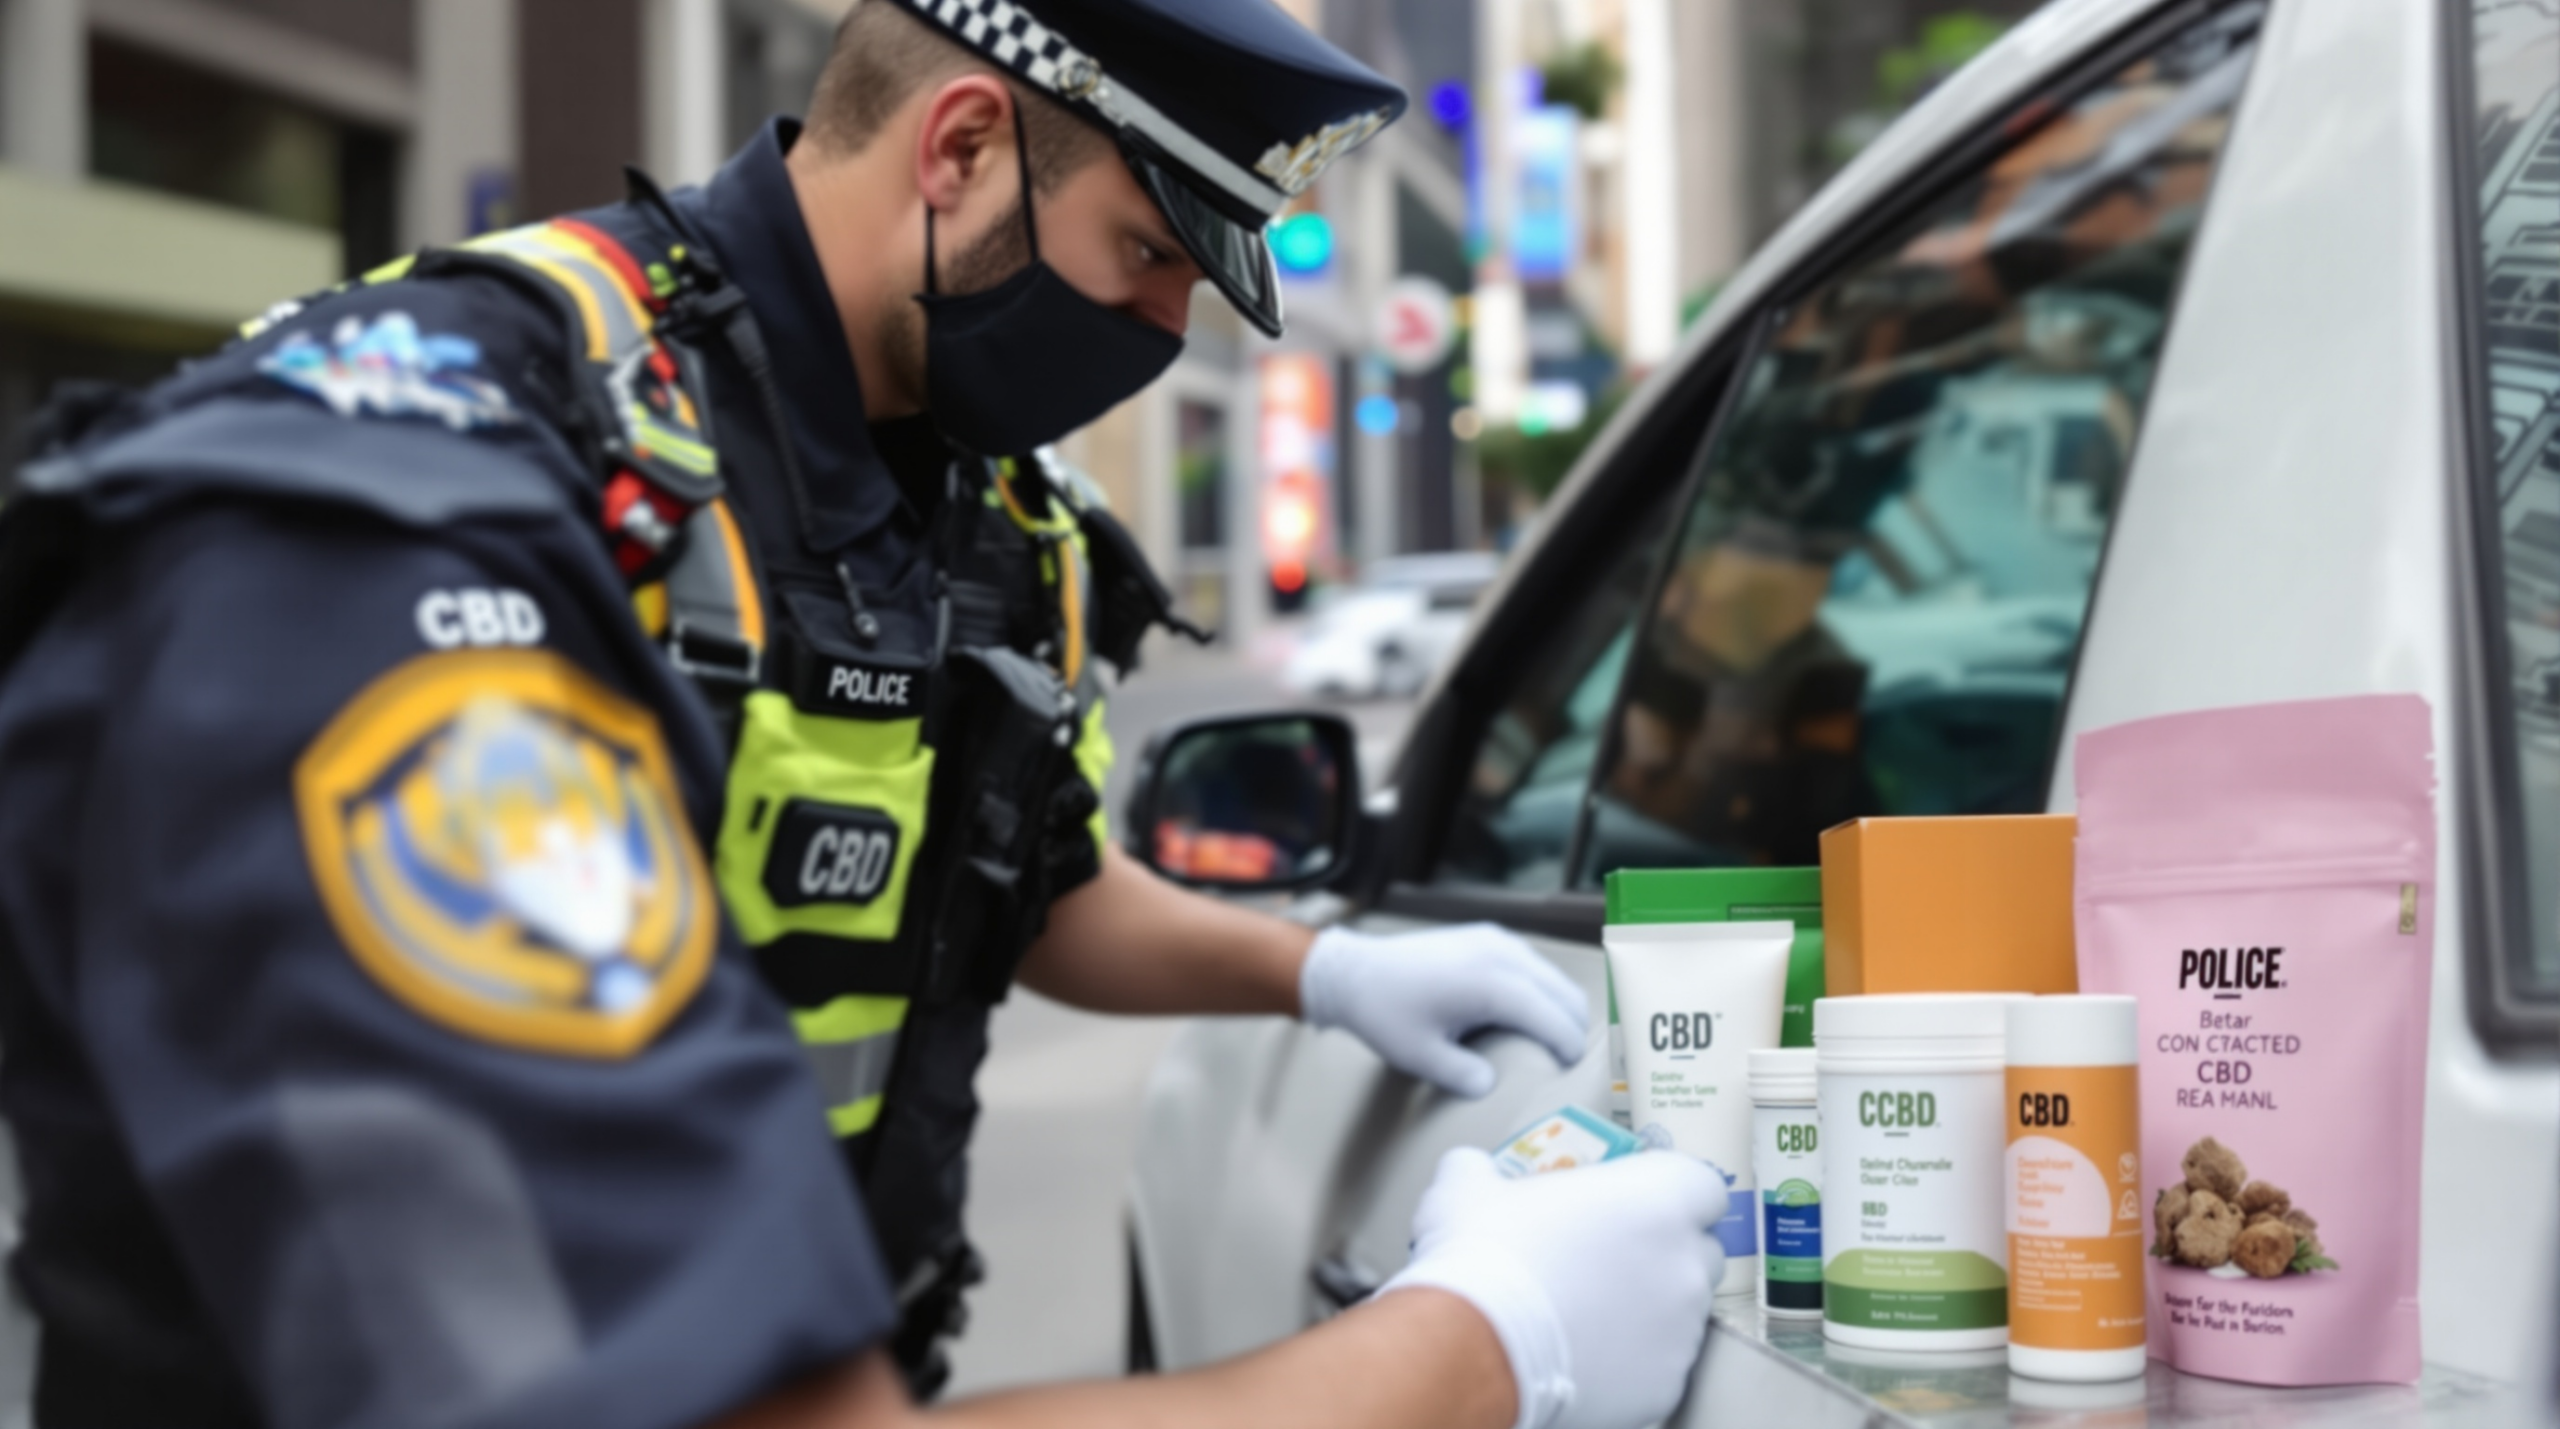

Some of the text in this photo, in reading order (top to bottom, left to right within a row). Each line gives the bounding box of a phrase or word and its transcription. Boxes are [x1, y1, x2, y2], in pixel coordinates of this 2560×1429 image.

[416, 590, 545, 647] CBD
[828, 666, 912, 705] POLICE
[800, 827, 892, 895] CBD
[2178, 947, 2283, 990] POLICE
[1650, 1011, 1713, 1052] CBD
[2199, 1010, 2252, 1030] Betar
[2156, 1034, 2201, 1054] CON
[2197, 1060, 2253, 1085] CBD
[1859, 1091, 1937, 1128] CCBD
[2020, 1092, 2070, 1127] CBD
[2176, 1088, 2279, 1111] REA MANL
[1777, 1124, 1818, 1153] CBD
